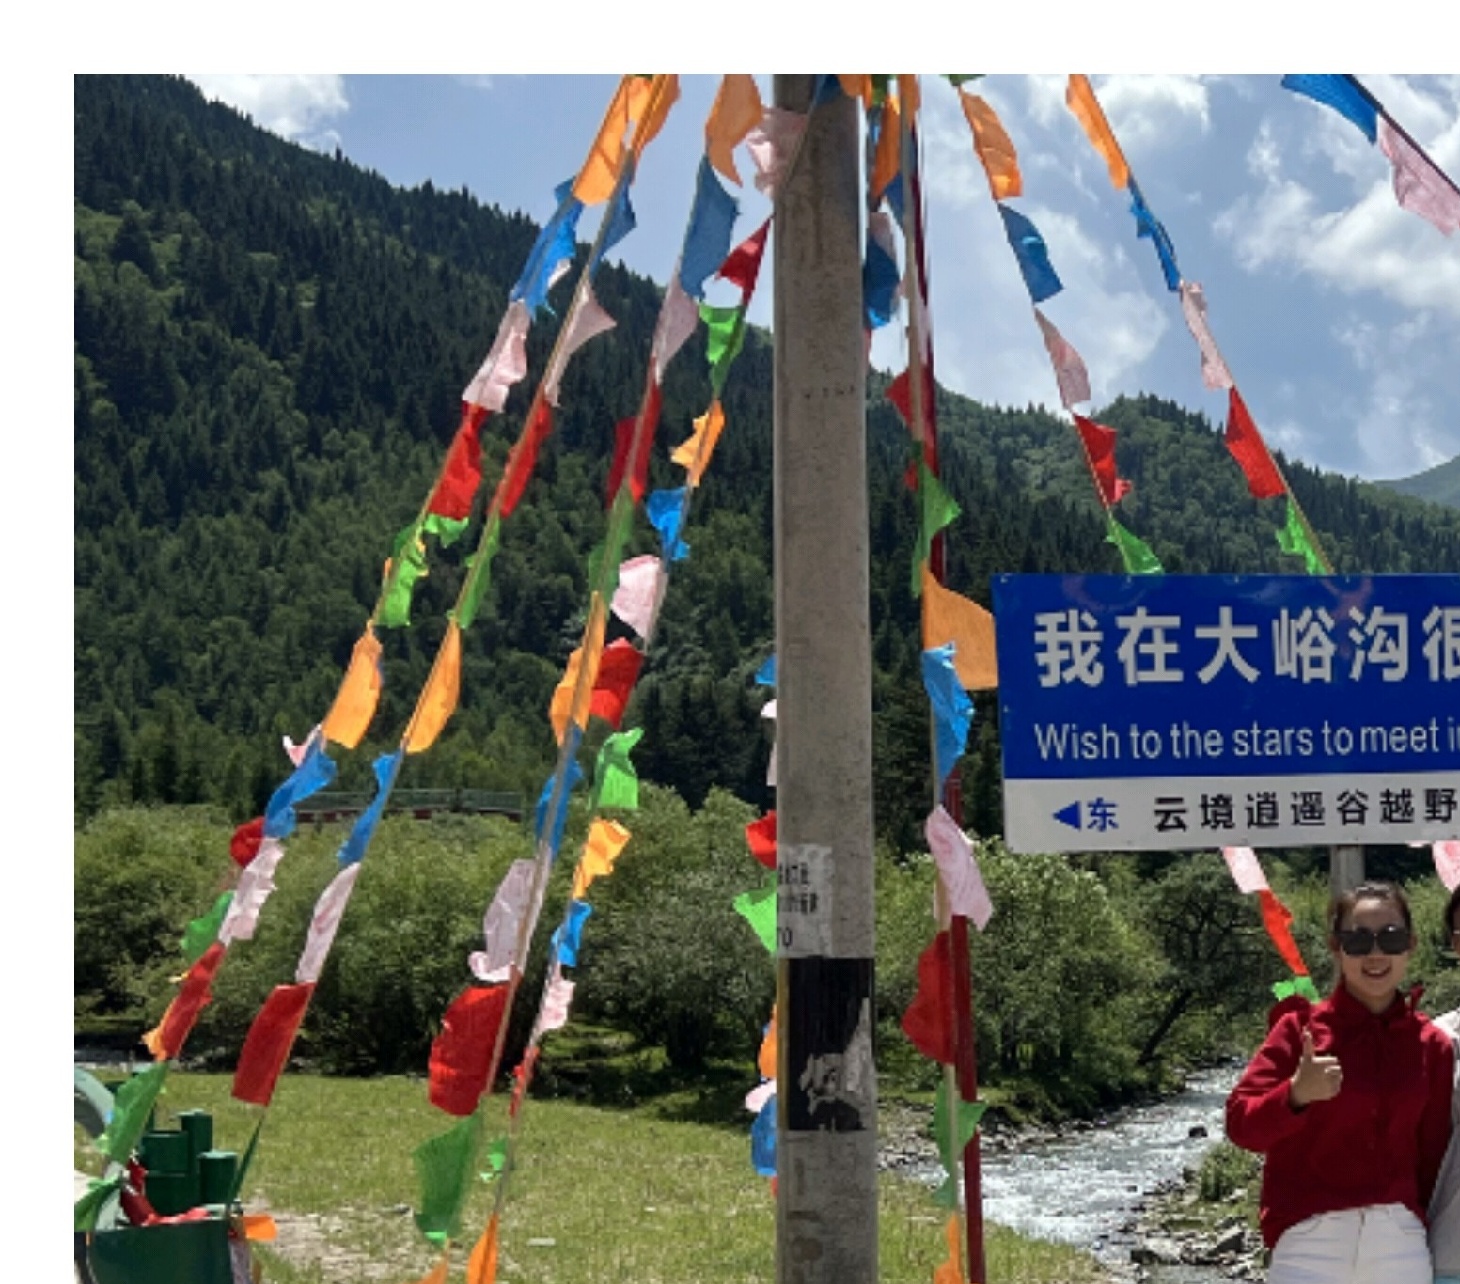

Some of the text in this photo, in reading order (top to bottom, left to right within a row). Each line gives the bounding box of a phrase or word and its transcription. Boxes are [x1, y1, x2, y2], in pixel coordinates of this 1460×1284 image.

[1034, 722, 1120, 761] Wish
[1128, 724, 1162, 759] to
[1169, 722, 1224, 758] the
[1233, 722, 1314, 757] stars
[1321, 720, 1353, 756] to
[1360, 717, 1440, 754] meet
[1087, 798, 1119, 831] 东
